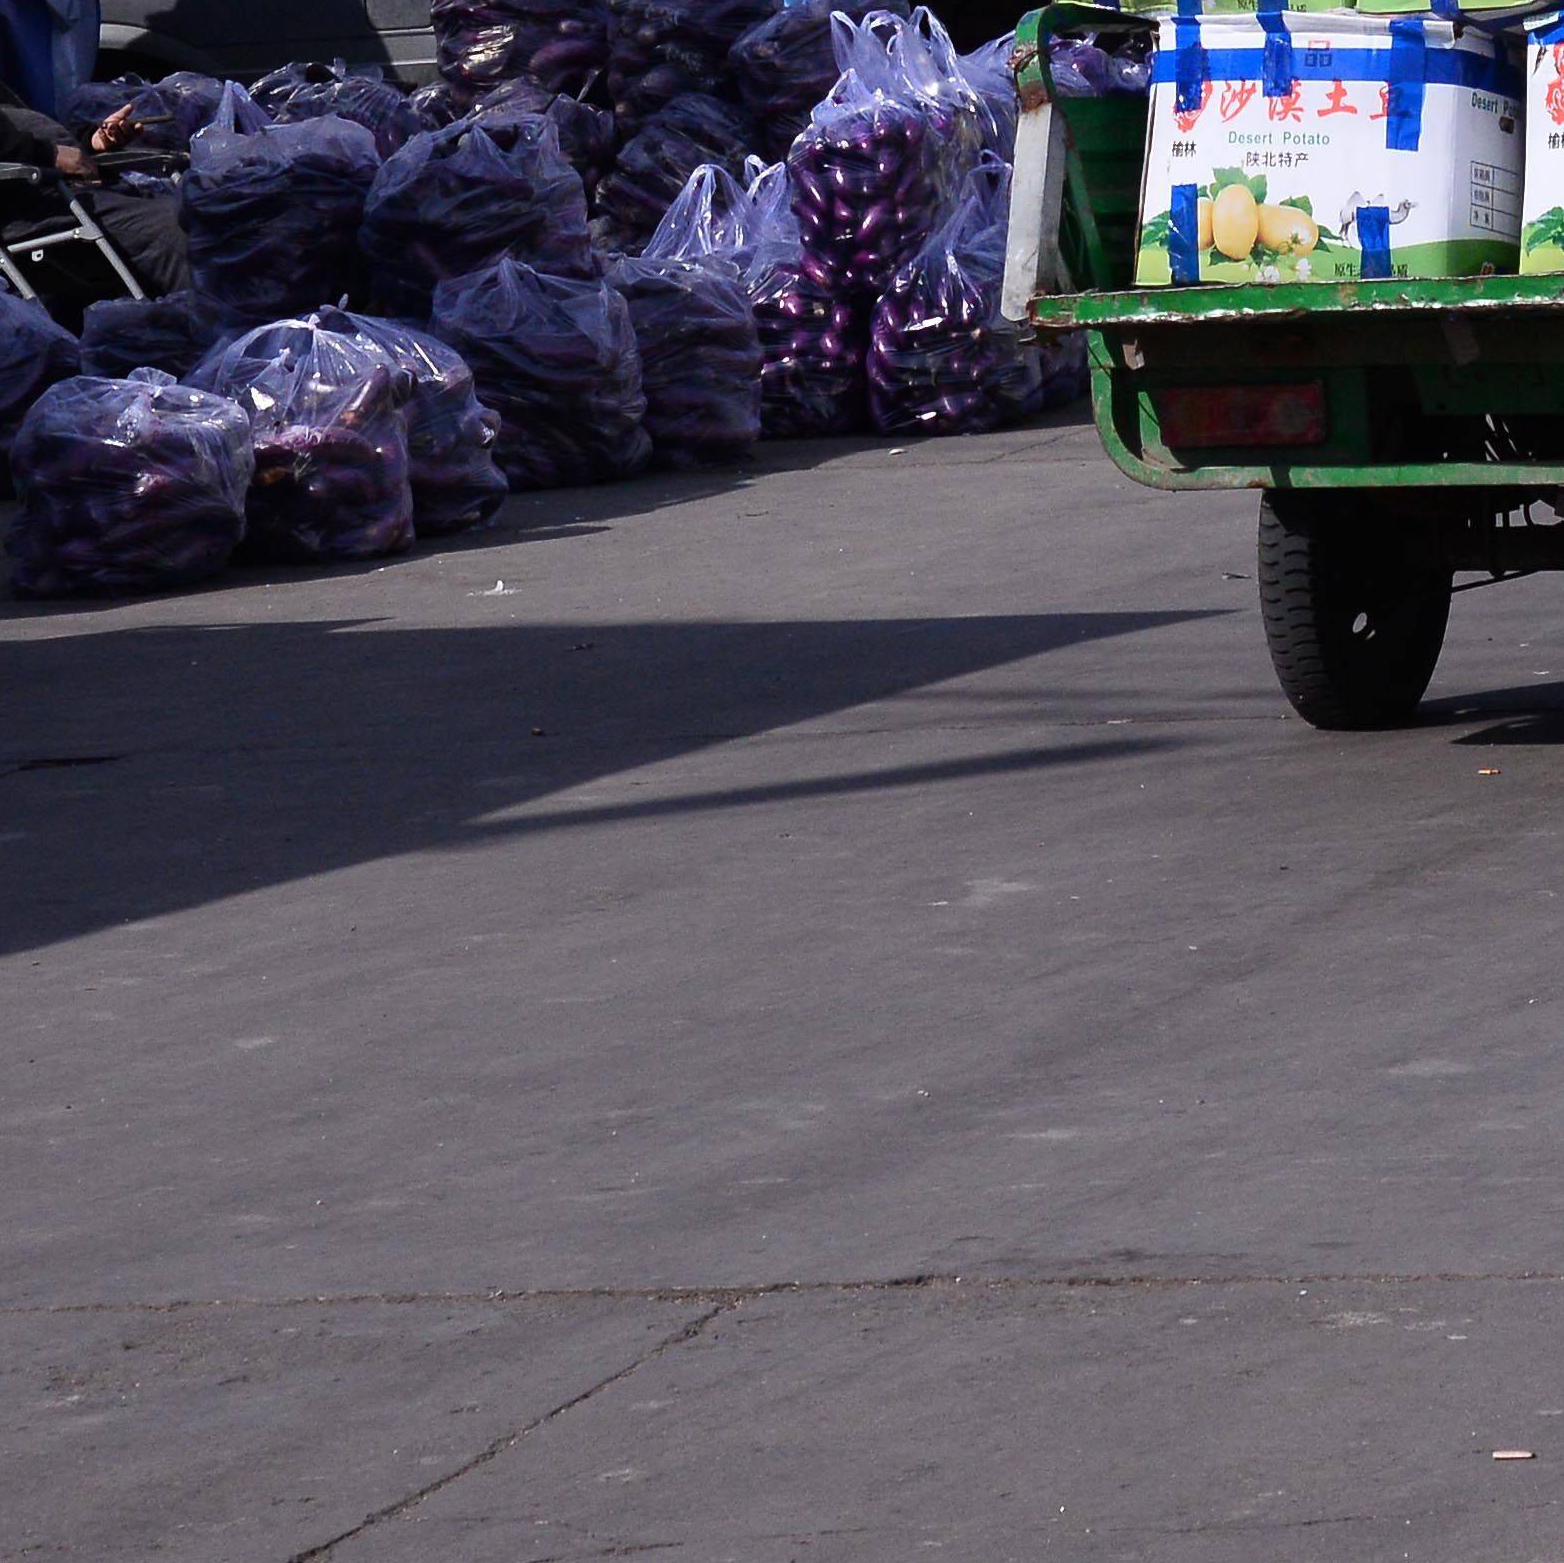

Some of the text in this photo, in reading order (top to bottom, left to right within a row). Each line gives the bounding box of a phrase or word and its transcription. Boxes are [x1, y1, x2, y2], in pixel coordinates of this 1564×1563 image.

[1472, 92, 1498, 114] Desert
[1228, 131, 1330, 146] Desert Potato
[1172, 141, 1196, 157] 榆林
[1245, 151, 1309, 168] 陕北特产
